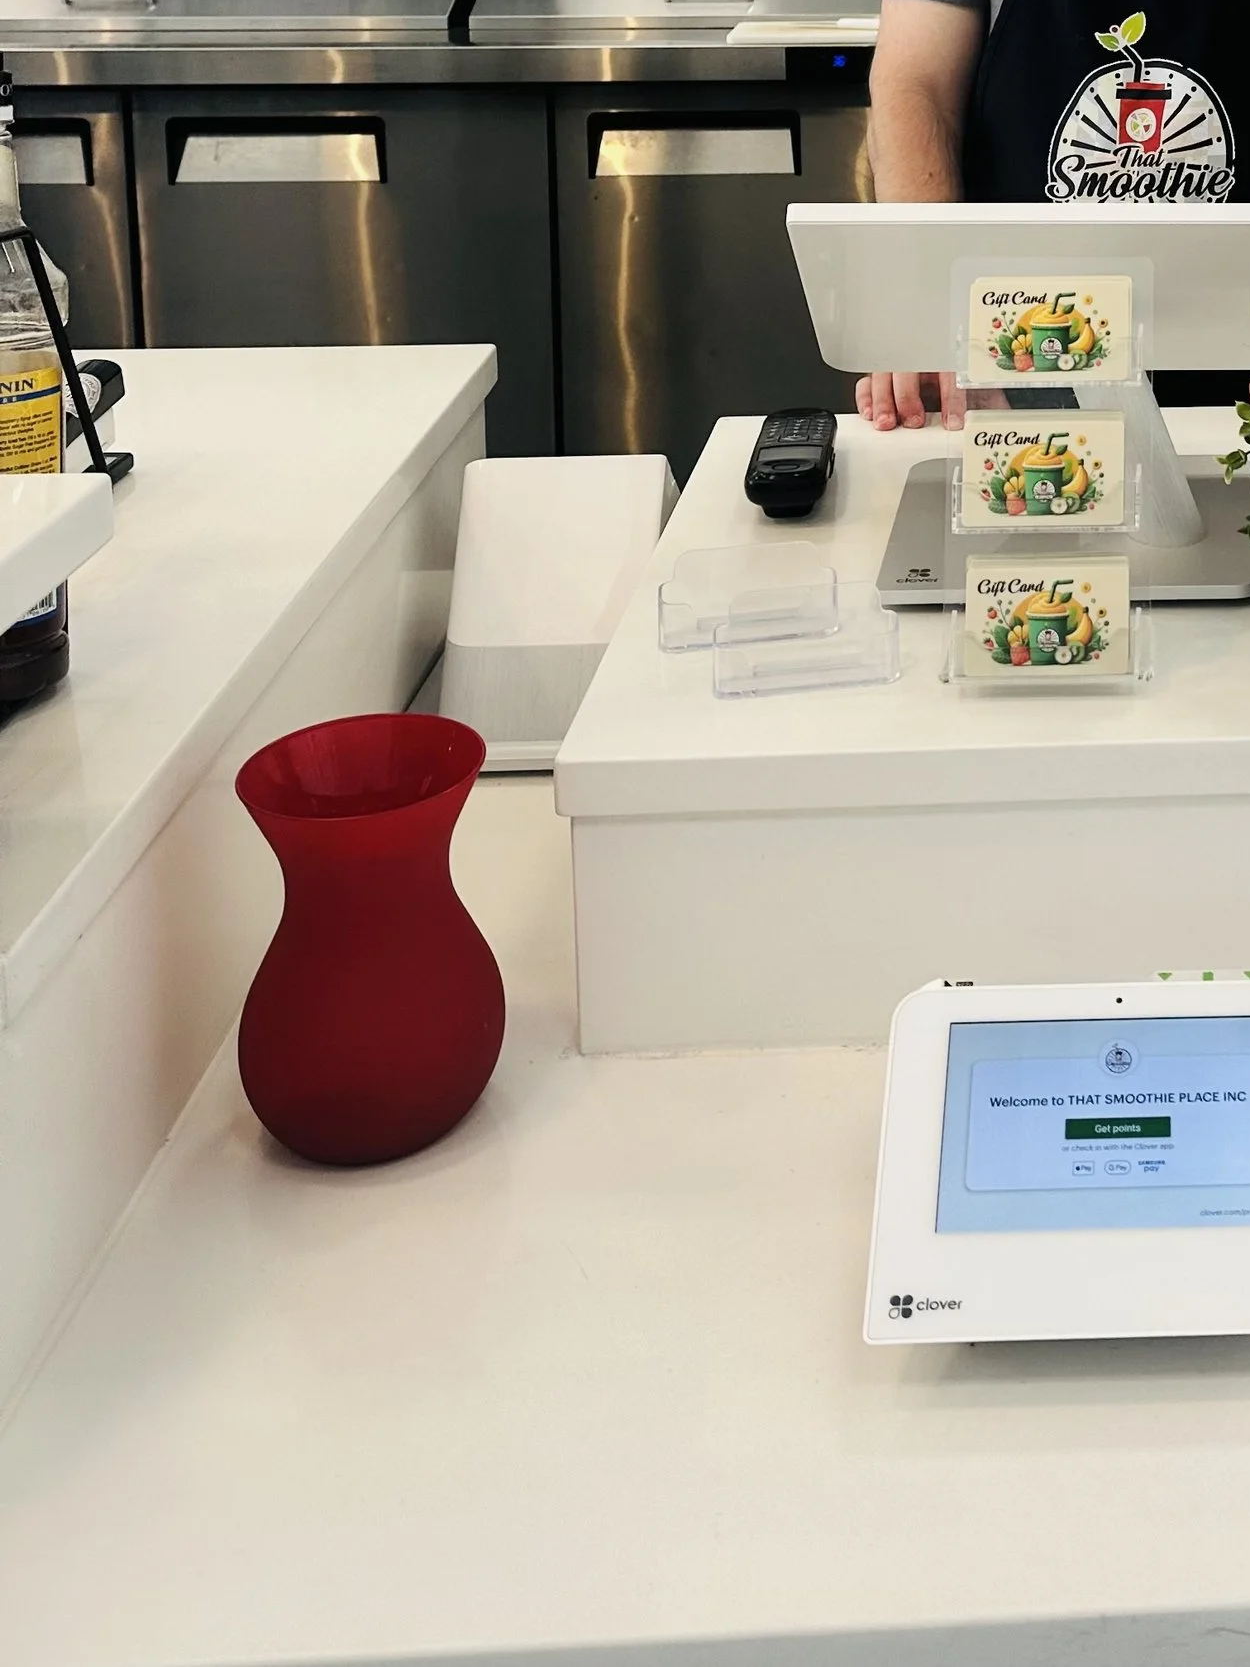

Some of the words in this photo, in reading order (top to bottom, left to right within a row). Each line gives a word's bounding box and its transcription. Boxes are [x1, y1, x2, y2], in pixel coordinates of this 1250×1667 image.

[1112, 144, 1164, 168] That
[1046, 154, 1235, 199] Smoothie
[982, 291, 1010, 307] Gift
[1012, 291, 1047, 306] Card
[974, 432, 1001, 447] Gift
[1004, 432, 1040, 446] Card
[977, 579, 1005, 595] Gift
[1008, 579, 1045, 594] Card
[990, 1097, 1048, 1107] Welcome
[1052, 1097, 1064, 1106] to
[1068, 1095, 1101, 1106] THAT
[1104, 1093, 1175, 1105] SMOOTHIE
[1179, 1092, 1219, 1103] PLACE
[1224, 1091, 1246, 1102] INC
[1095, 1124, 1111, 1133] Get
[1113, 1123, 1141, 1135] points
[916, 1296, 963, 1313] clover
